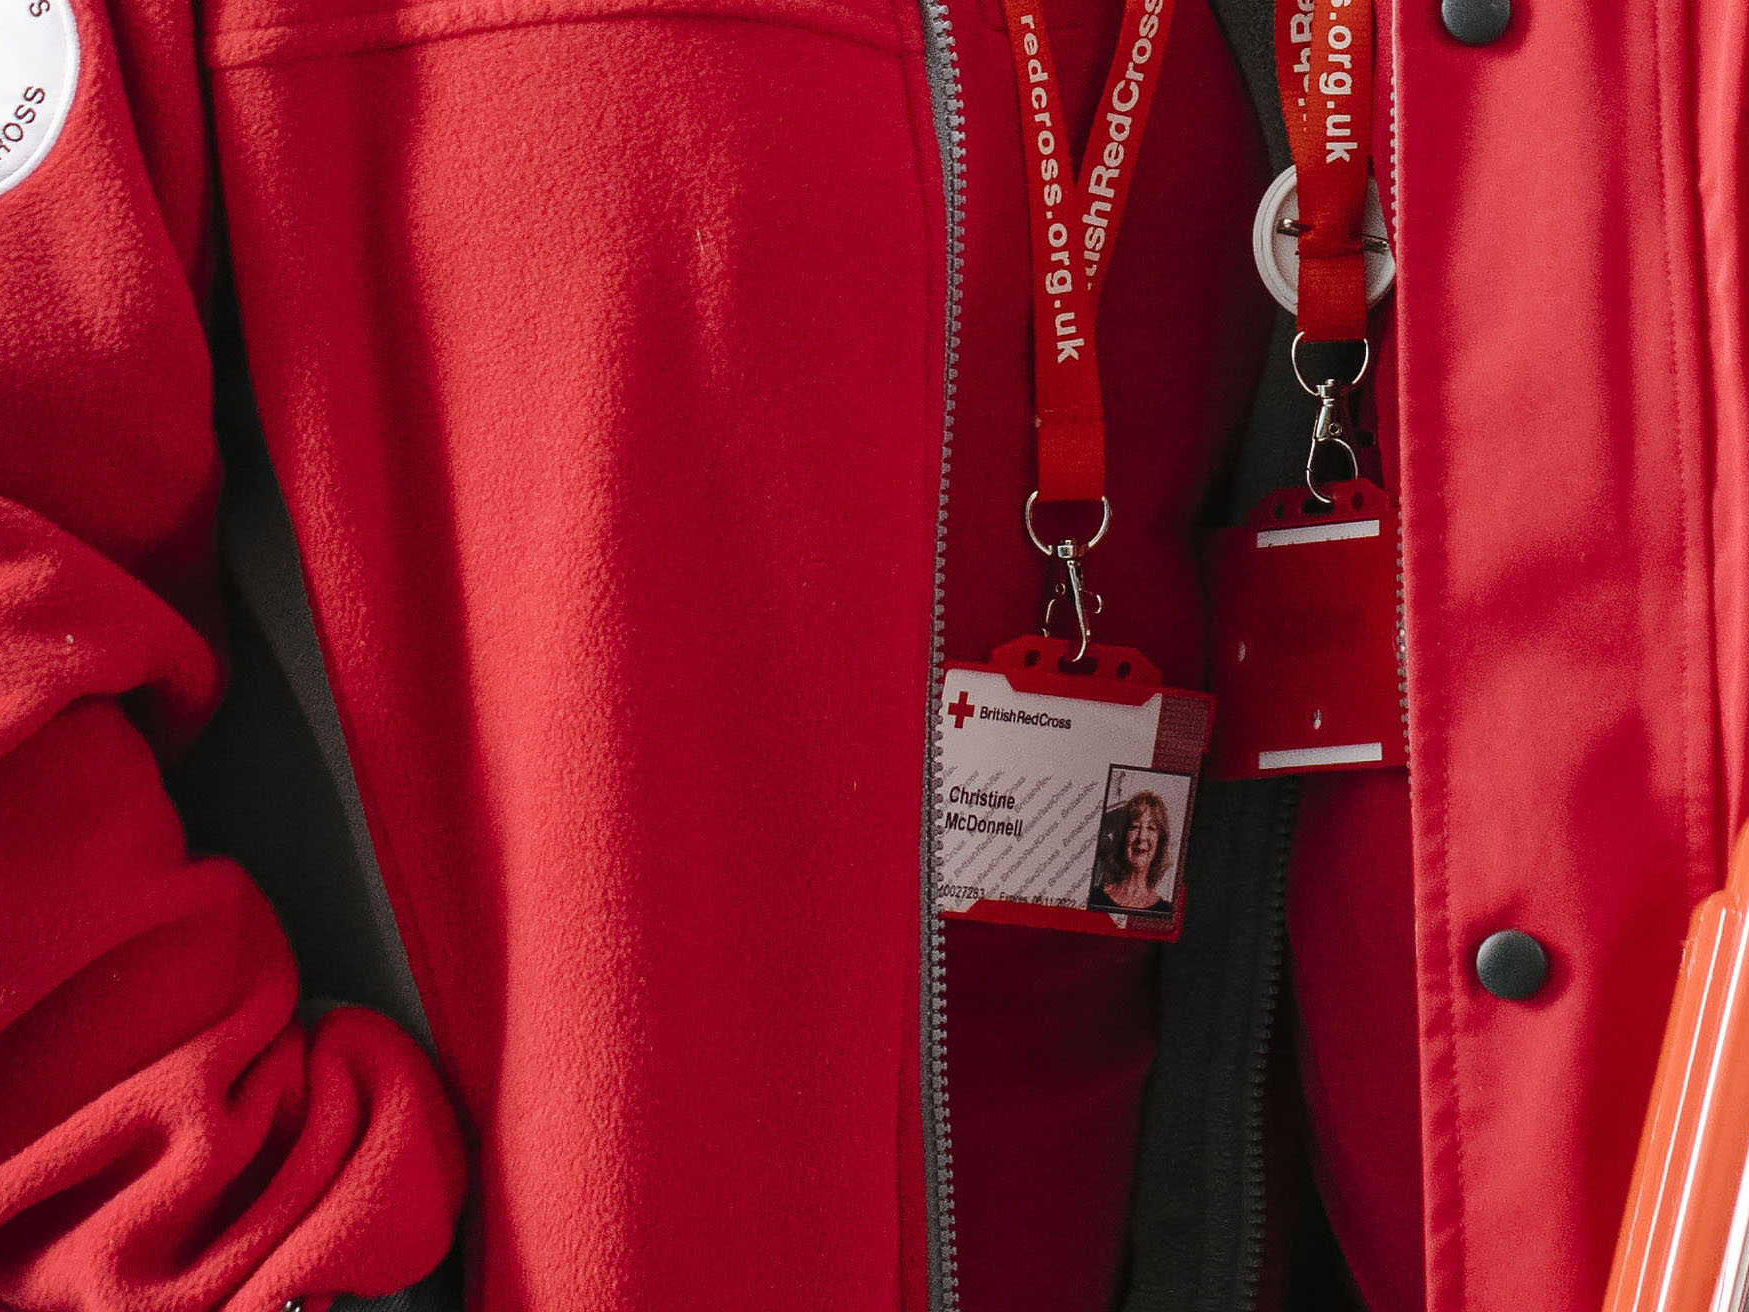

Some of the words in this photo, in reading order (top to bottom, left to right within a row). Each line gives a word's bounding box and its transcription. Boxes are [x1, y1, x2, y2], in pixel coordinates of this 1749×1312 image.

[1018, 14, 1085, 364] redcross.org.uk
[949, 786, 1016, 809] Christine
[945, 812, 1023, 836] McDonnell
